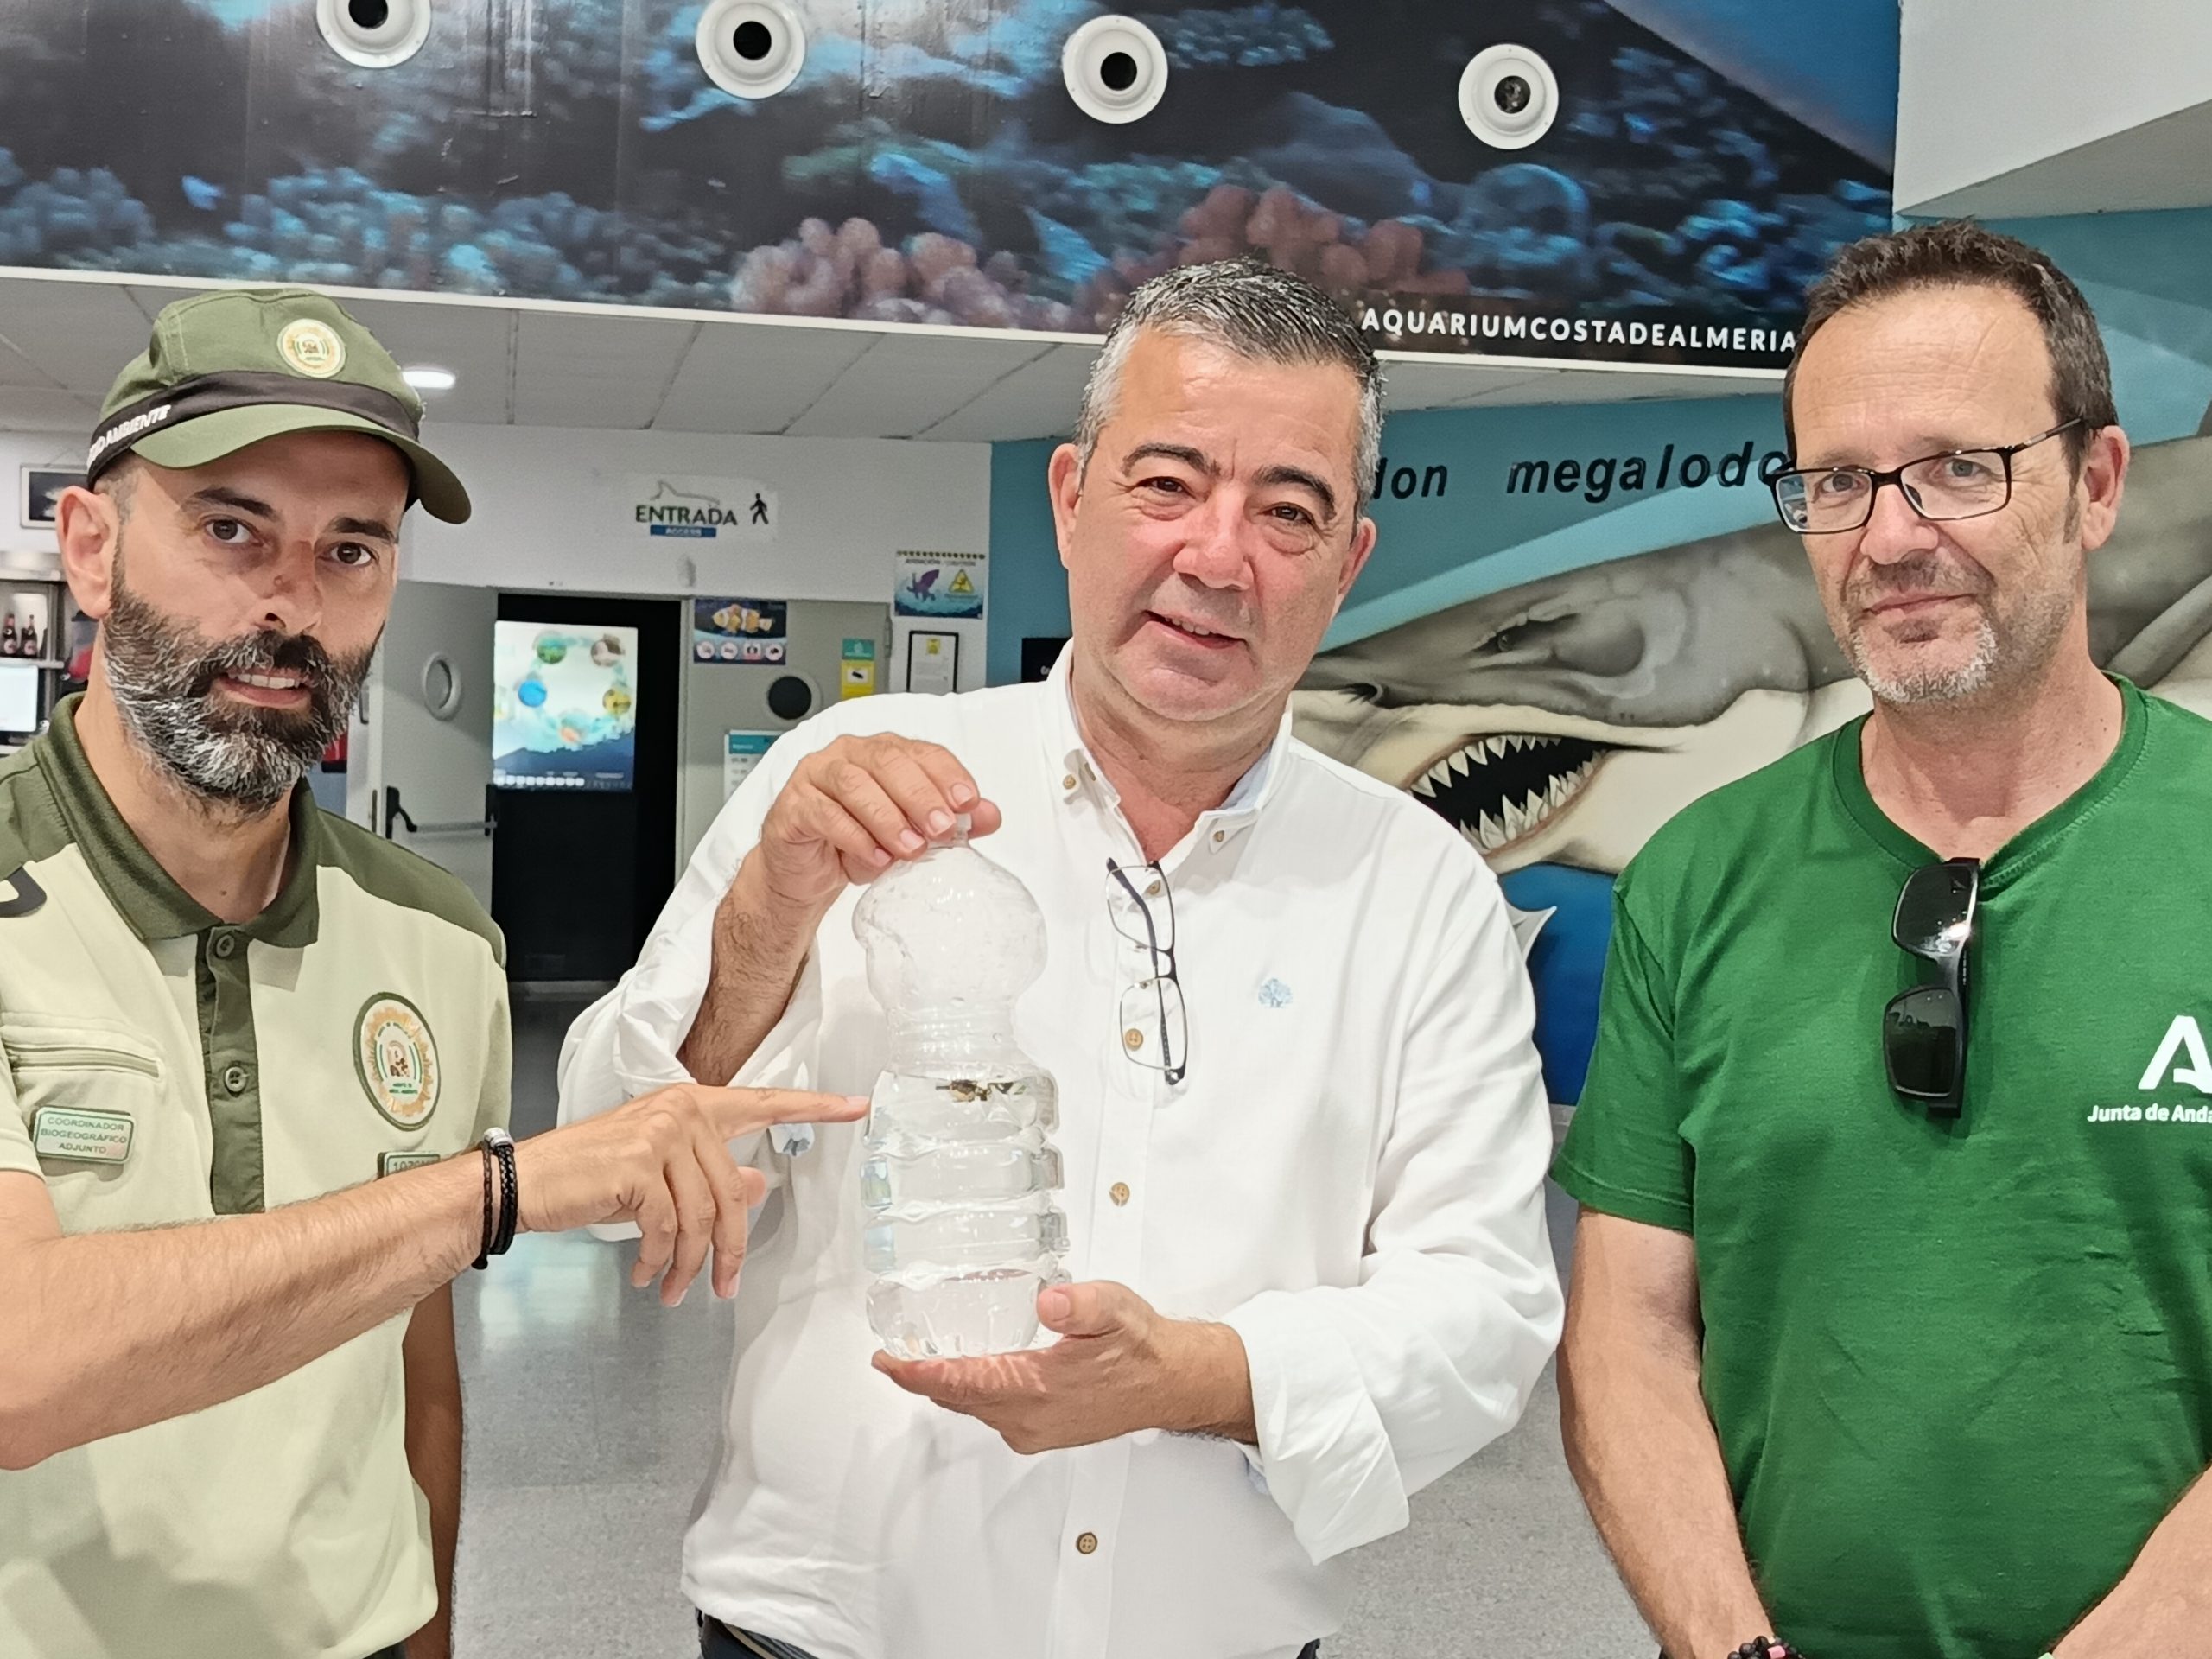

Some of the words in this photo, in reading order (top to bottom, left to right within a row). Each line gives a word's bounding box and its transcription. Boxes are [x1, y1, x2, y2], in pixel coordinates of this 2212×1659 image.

[1361, 308, 1796, 353] AQUARIUMCOSTADEALMERIA
[635, 505, 737, 526] ENTRADA
[2087, 1104, 2142, 1122] Junta
[2145, 1103, 2170, 1122] de
[48, 1117, 124, 1131] COORDINADOR
[41, 1128, 127, 1144] BIOGEOGRÁFICO
[59, 1143, 106, 1154] ADJUNTO
